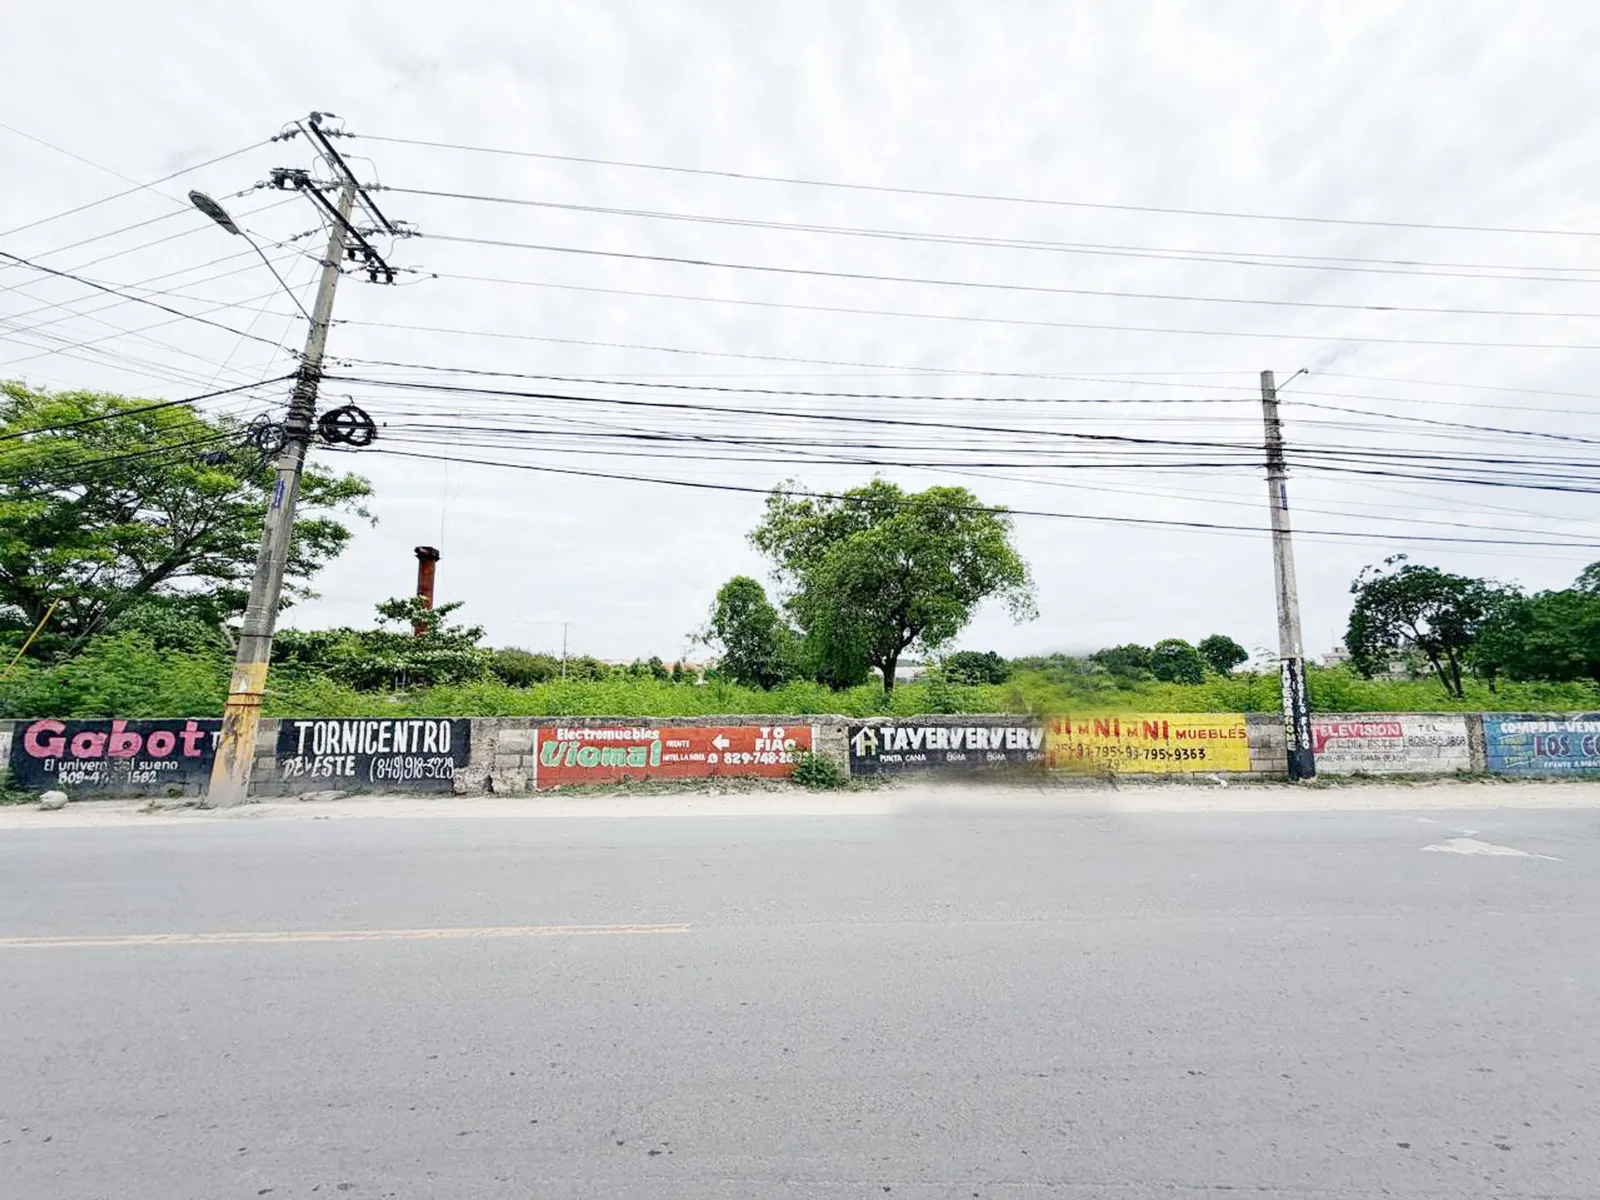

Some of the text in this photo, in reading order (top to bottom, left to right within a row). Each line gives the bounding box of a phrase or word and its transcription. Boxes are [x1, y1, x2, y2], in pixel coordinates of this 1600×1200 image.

[24, 720, 205, 759] Gabot
[294, 721, 451, 754] TORNICENTRO
[557, 728, 660, 740] Electromuebles
[760, 727, 785, 739] TO
[1176, 728, 1247, 740] MUEBLES
[1311, 723, 1401, 748] TELEVISION
[755, 739, 796, 751] FIAO
[1533, 734, 1571, 757] LOS
[44, 758, 55, 771] El
[311, 755, 356, 777] ESTE
